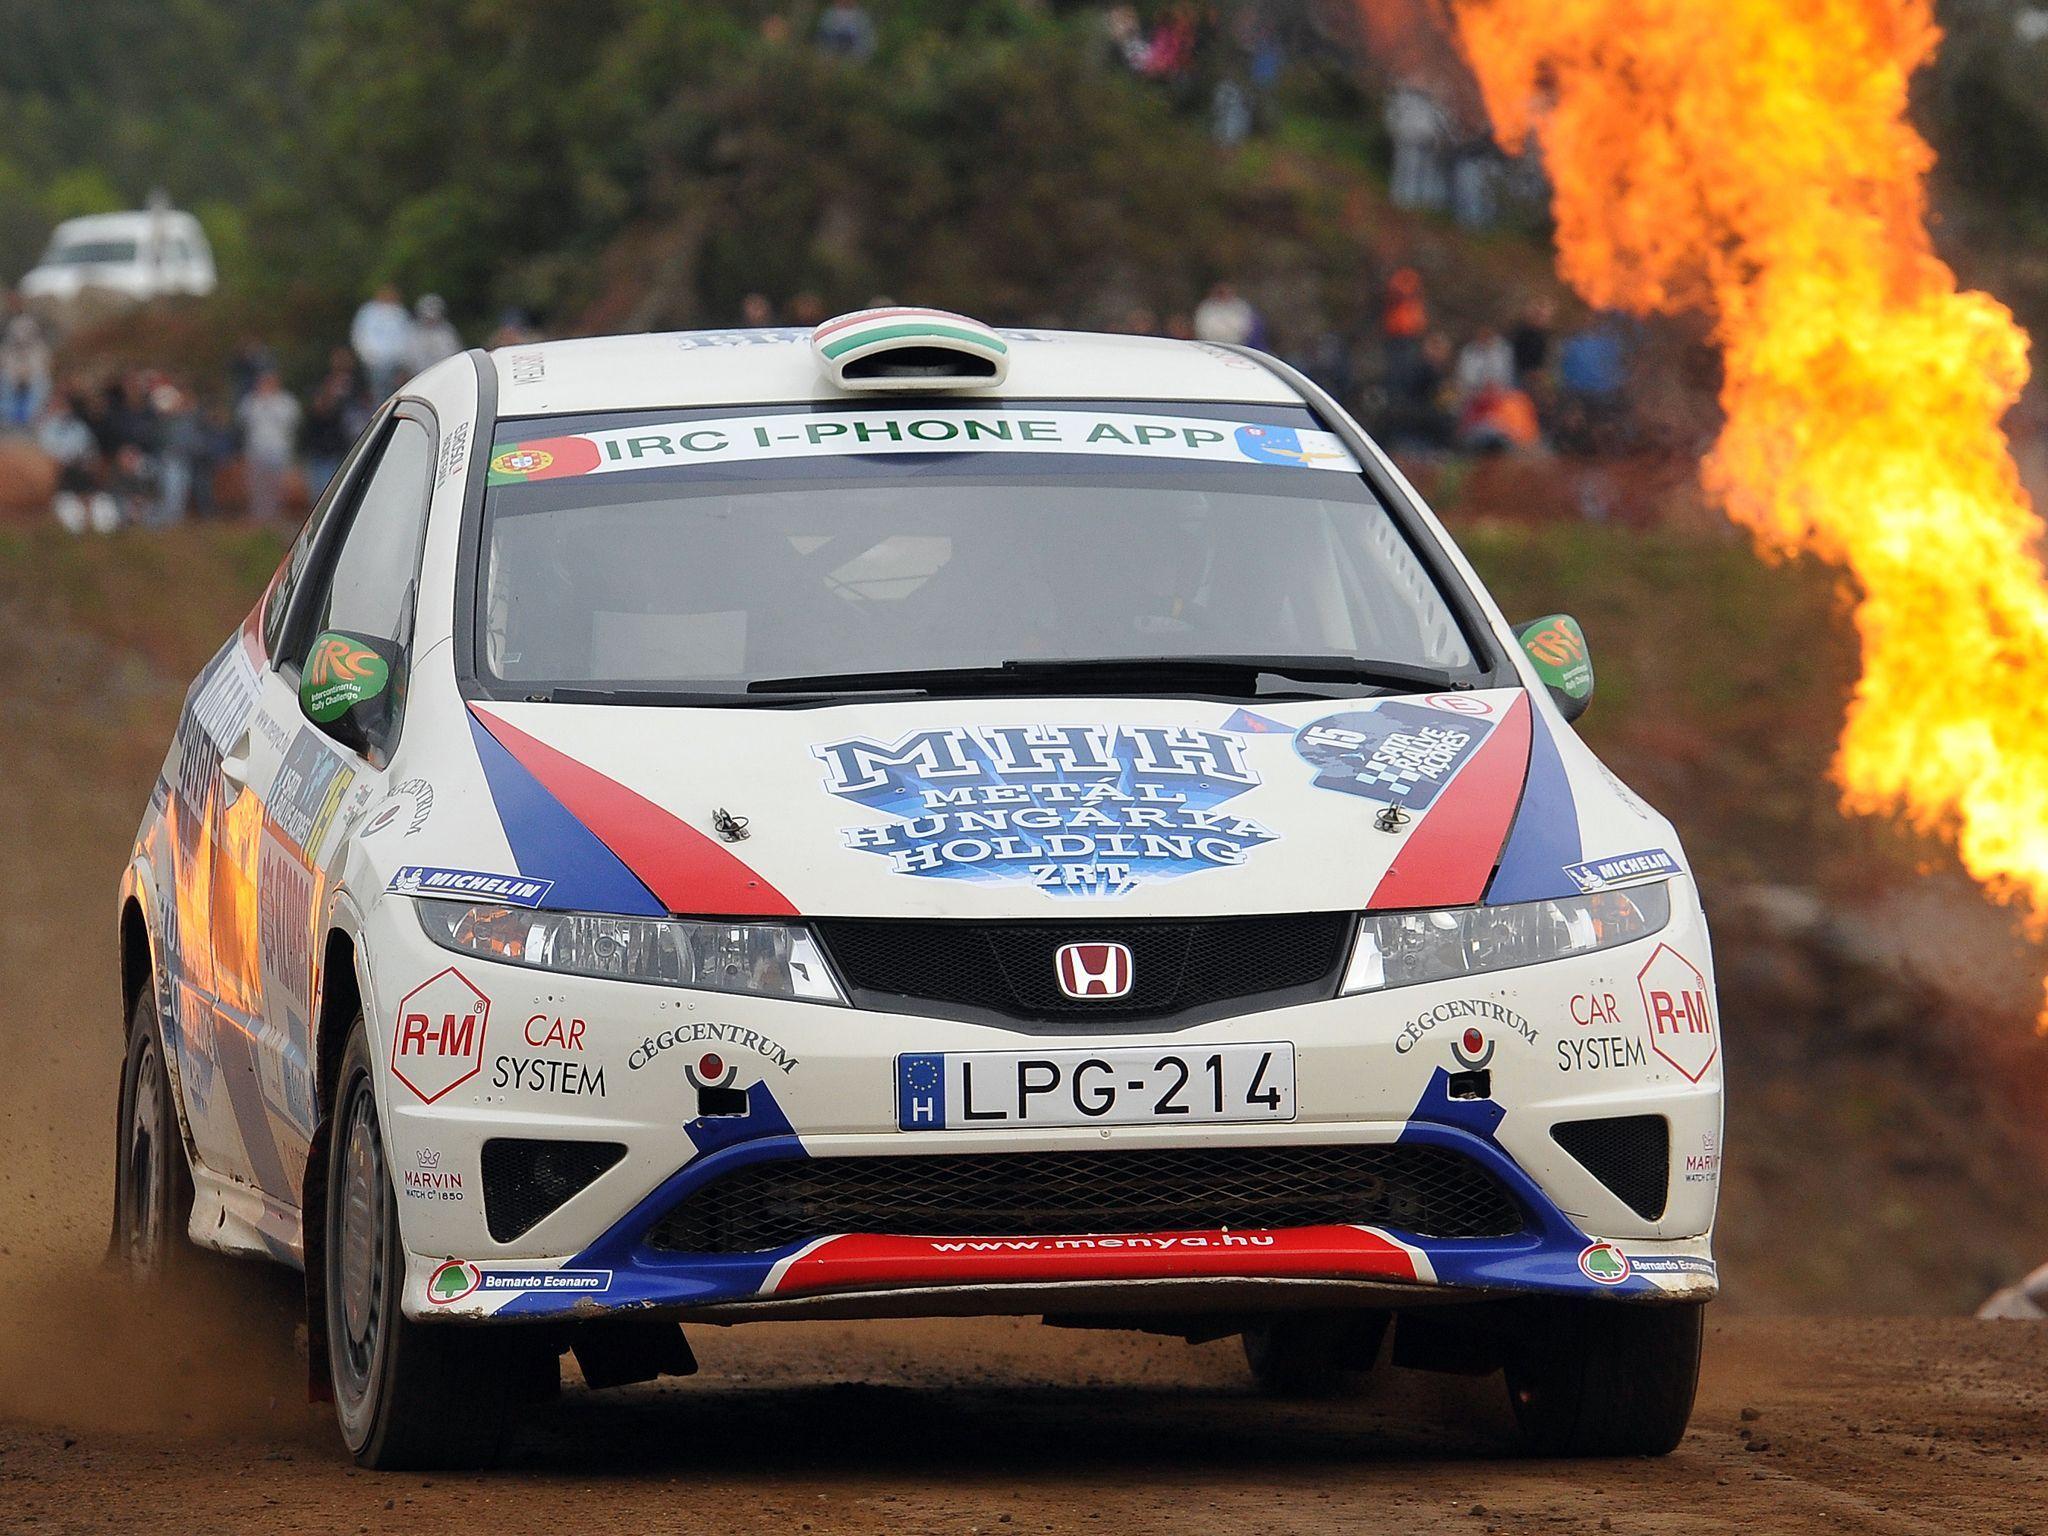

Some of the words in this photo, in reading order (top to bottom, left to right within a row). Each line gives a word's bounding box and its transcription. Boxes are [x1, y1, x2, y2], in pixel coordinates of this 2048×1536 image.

[605, 431, 729, 460] IRC
[755, 419, 1062, 448] I-PHONE
[1086, 424, 1224, 448] APP
[826, 727, 1256, 789] MHH
[1372, 733, 1415, 765] SATA
[1417, 730, 1471, 780] AÇORES
[922, 777, 1188, 808] METÁL
[843, 801, 1280, 848] HUNGÁRIA
[890, 833, 1247, 875] HOLDING
[1598, 853, 1672, 879] MICHELIN
[425, 872, 541, 898] MICHELIN
[1395, 999, 1540, 1054] CÉGCENTRUM
[1570, 993, 1621, 1026] CAR
[1650, 991, 1710, 1034] R-M
[401, 1014, 476, 1056] R-M
[524, 1014, 586, 1051] CAR
[628, 1022, 800, 1076] CÉGCENTRUM
[1557, 1036, 1647, 1071] SYSTEM
[492, 1056, 606, 1097] SYSTEM
[962, 1052, 1282, 1121] LPG-214
[912, 1097, 934, 1122] H
[404, 1170, 463, 1188] MARVIN
[406, 1189, 425, 1200] WATCH
[438, 1191, 464, 1201] 1850
[931, 1233, 1275, 1251] www.menya.hu
[486, 1276, 541, 1287] Bernardo
[1631, 1260, 1680, 1271] Bernardo
